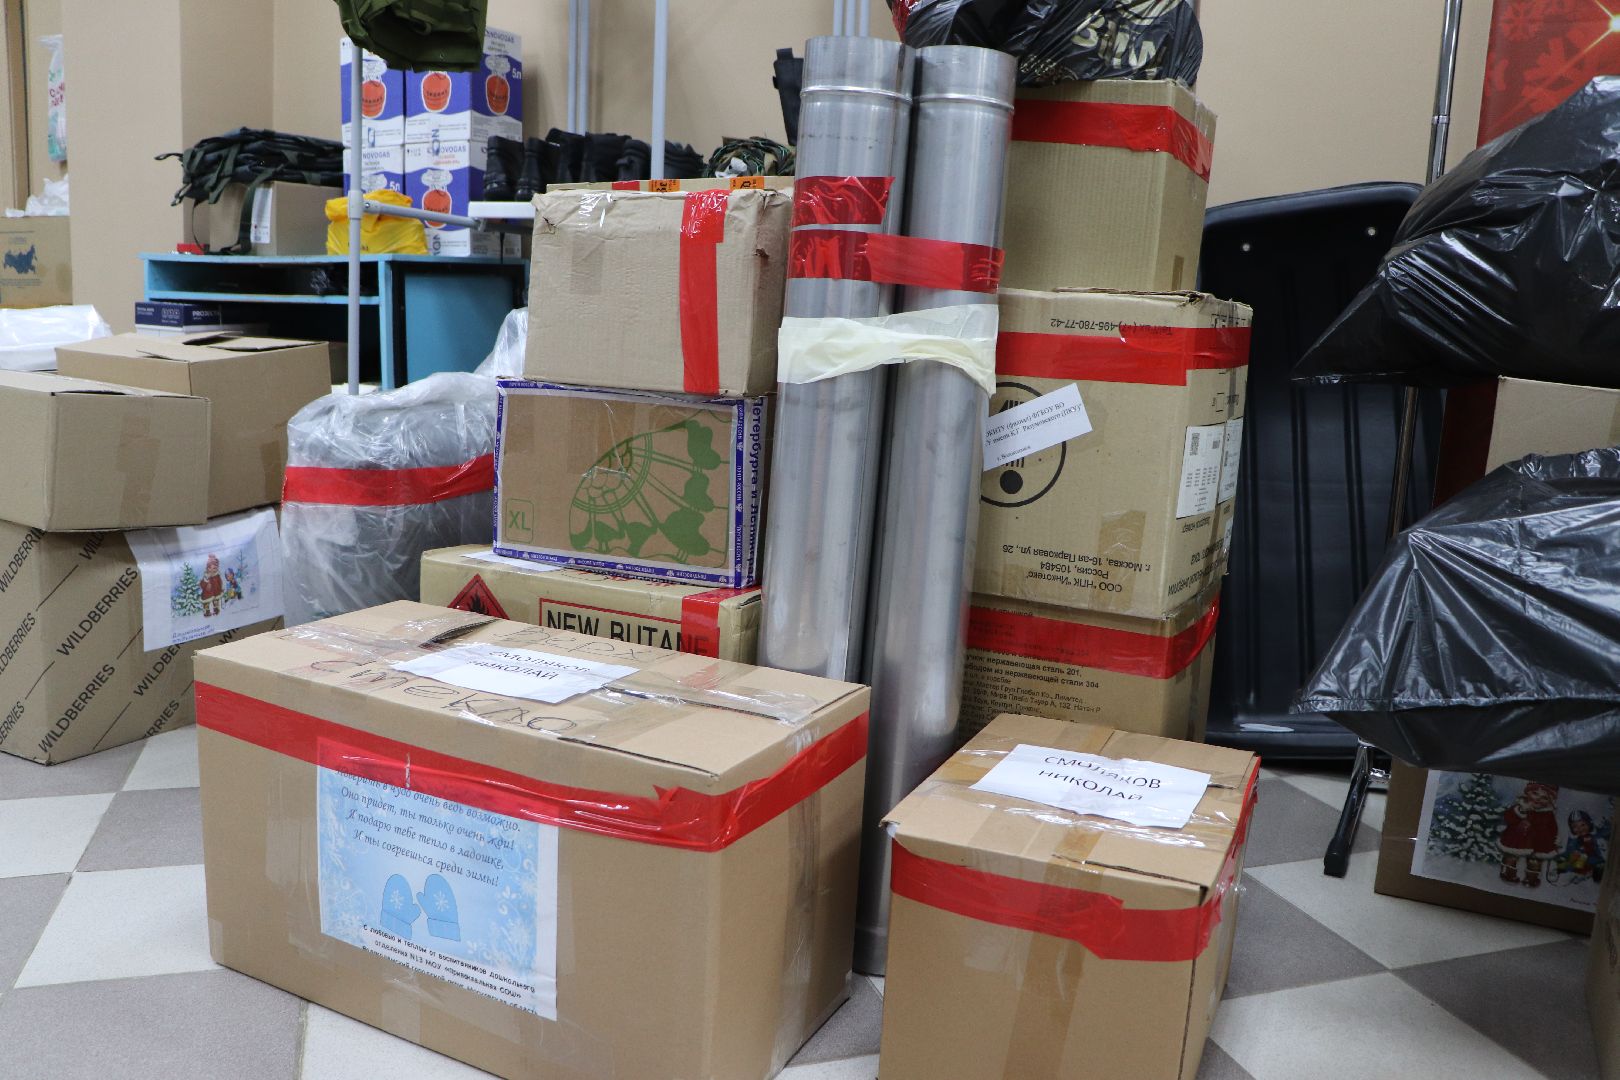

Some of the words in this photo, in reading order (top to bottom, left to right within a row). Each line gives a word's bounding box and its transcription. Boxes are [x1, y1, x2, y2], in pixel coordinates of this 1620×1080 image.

[508, 510, 532, 531] XL
[0, 526, 47, 593] WILDBERRI
[1033, 549, 1076, 563] Парковая
[1040, 561, 1072, 574] 105484
[1078, 556, 1103, 567] 16-ая
[1106, 558, 1144, 573] Москва,
[1075, 565, 1109, 579] Россия,
[1098, 581, 1123, 593] ООО
[56, 567, 138, 656] WILDBERRIES
[547, 609, 600, 637] NEW
[38, 664, 116, 753] WILDBERRIES
[1038, 770, 1143, 800] НИКОЛАЙ
[1044, 756, 1161, 789] СМОЛЯКОВ
[341, 786, 359, 801] Оно
[361, 794, 397, 815] придет,
[400, 807, 417, 820] ты
[419, 813, 455, 835] только
[456, 826, 485, 841] очень
[487, 835, 515, 851] жди!
[413, 791, 440, 807] очень
[442, 800, 464, 813] ведь
[466, 807, 520, 832] возможно.
[345, 808, 358, 821] Я
[358, 813, 392, 832] подарю
[394, 826, 417, 840] тебе
[418, 832, 448, 850] тепло
[457, 848, 503, 870] ладошке,
[365, 835, 380, 848] ты
[382, 841, 433, 867] согреешься
[436, 860, 463, 875] среди
[466, 868, 499, 887] зимы!
[489, 971, 535, 994] дошкольного
